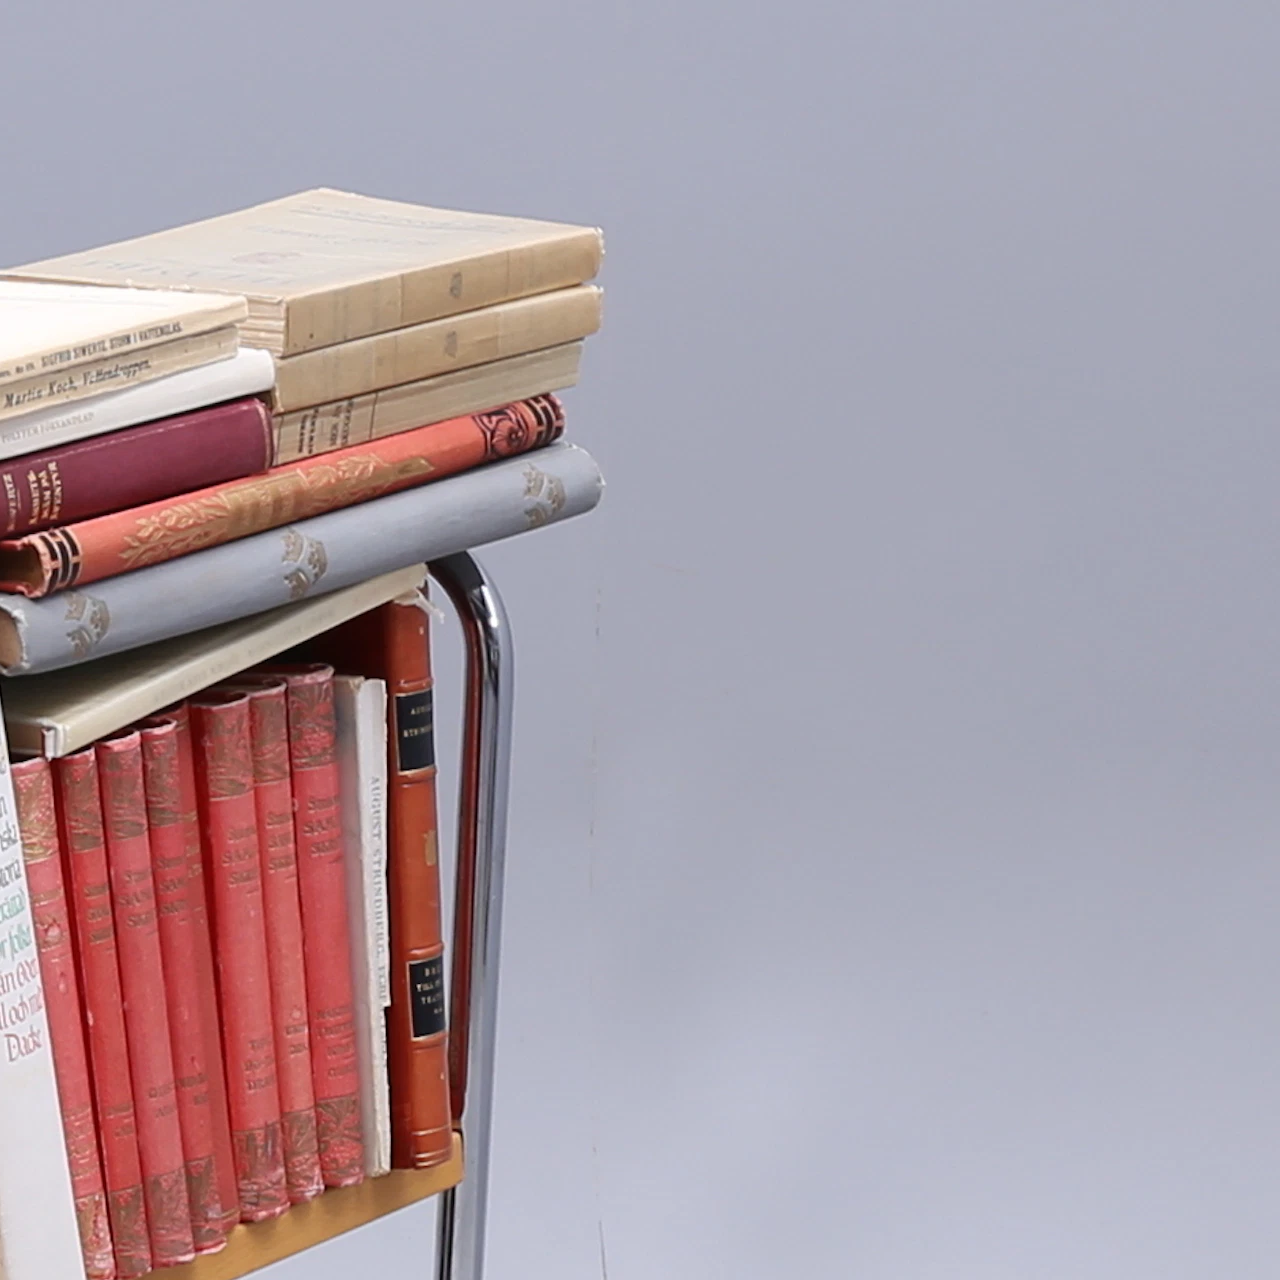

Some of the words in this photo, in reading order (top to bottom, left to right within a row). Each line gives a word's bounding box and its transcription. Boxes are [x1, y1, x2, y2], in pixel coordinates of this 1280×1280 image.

[40, 346, 72, 369] SIGFRID
[109, 333, 132, 351] STORM
[2, 383, 45, 409] Martin
[47, 377, 78, 398] Koch,
[370, 776, 383, 842] AUGUST
